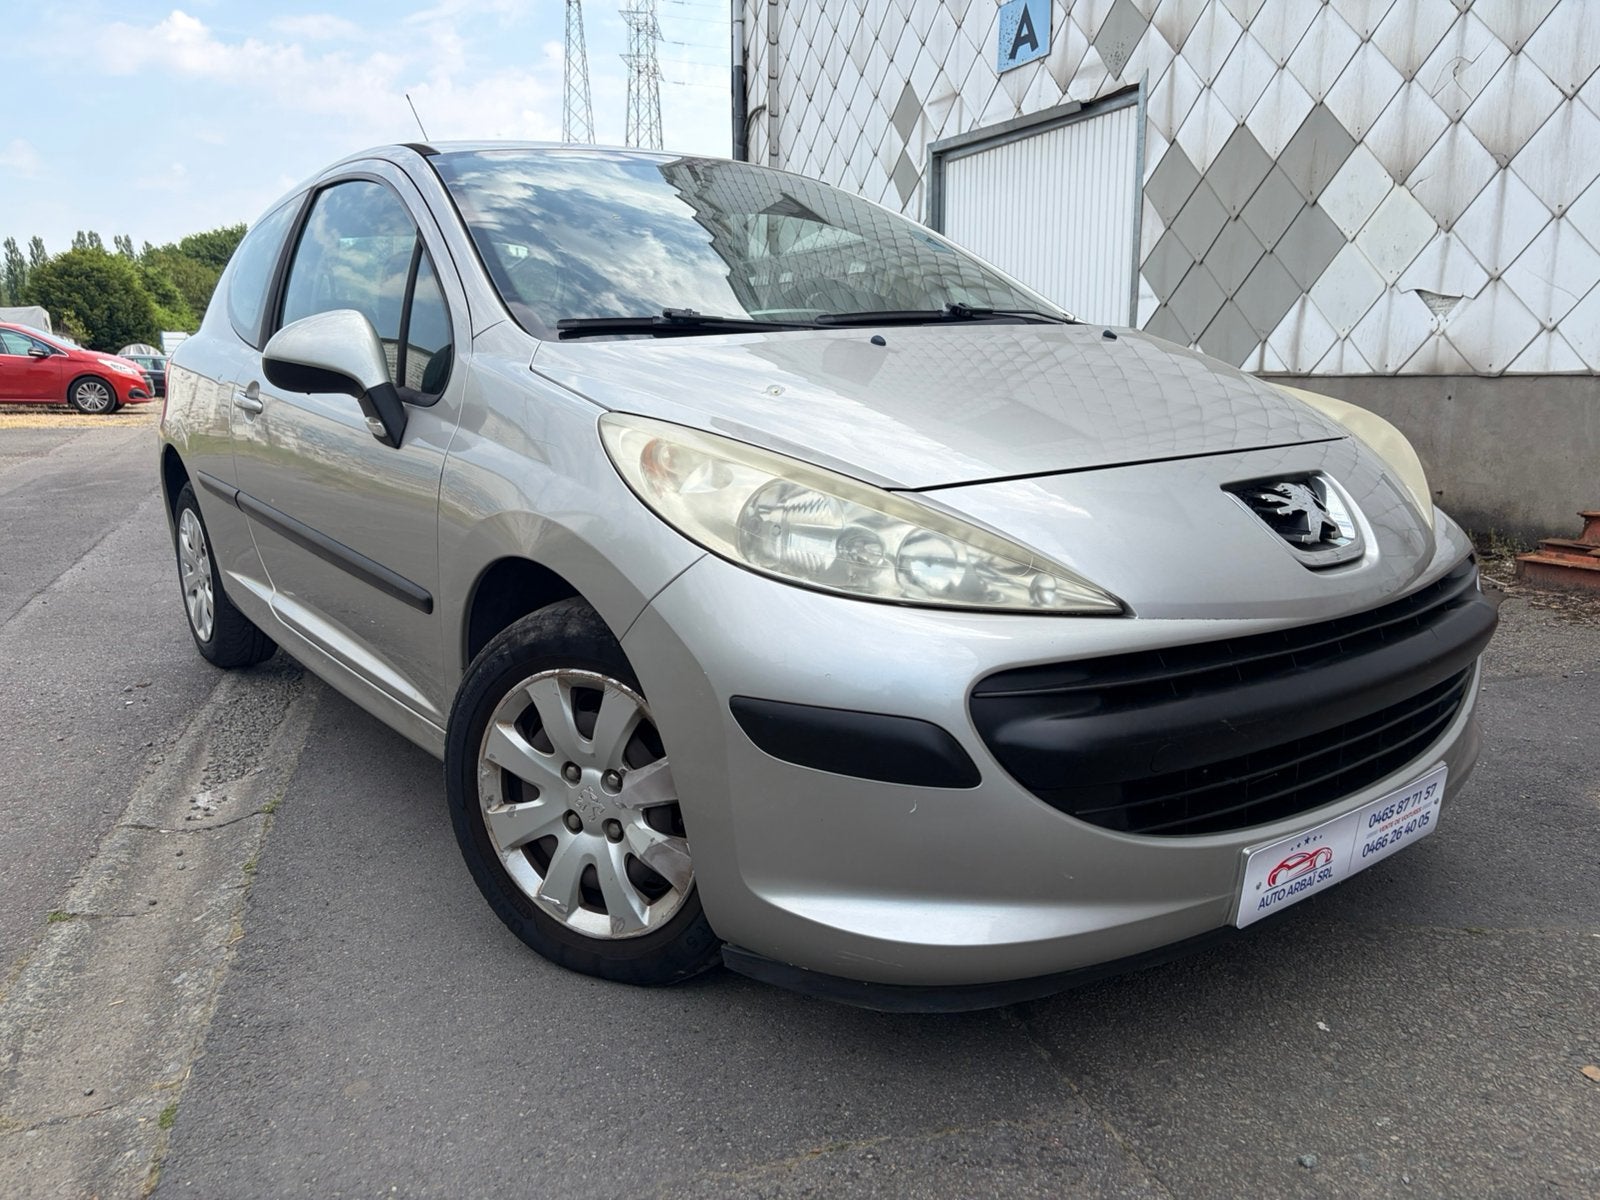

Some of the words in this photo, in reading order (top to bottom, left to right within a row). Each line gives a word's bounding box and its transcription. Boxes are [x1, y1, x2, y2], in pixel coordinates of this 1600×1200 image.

[1008, 2, 1039, 60] A
[1369, 804, 1396, 828] 0465
[1396, 797, 1411, 815] 87
[1411, 790, 1422, 807] 71
[1424, 782, 1437, 800] 57
[1362, 833, 1389, 858] 0466
[1389, 826, 1403, 844] 26
[1404, 819, 1417, 835] 40
[1418, 811, 1431, 828] 05
[1257, 888, 1286, 911] AUTO
[1317, 866, 1333, 883] SRL
